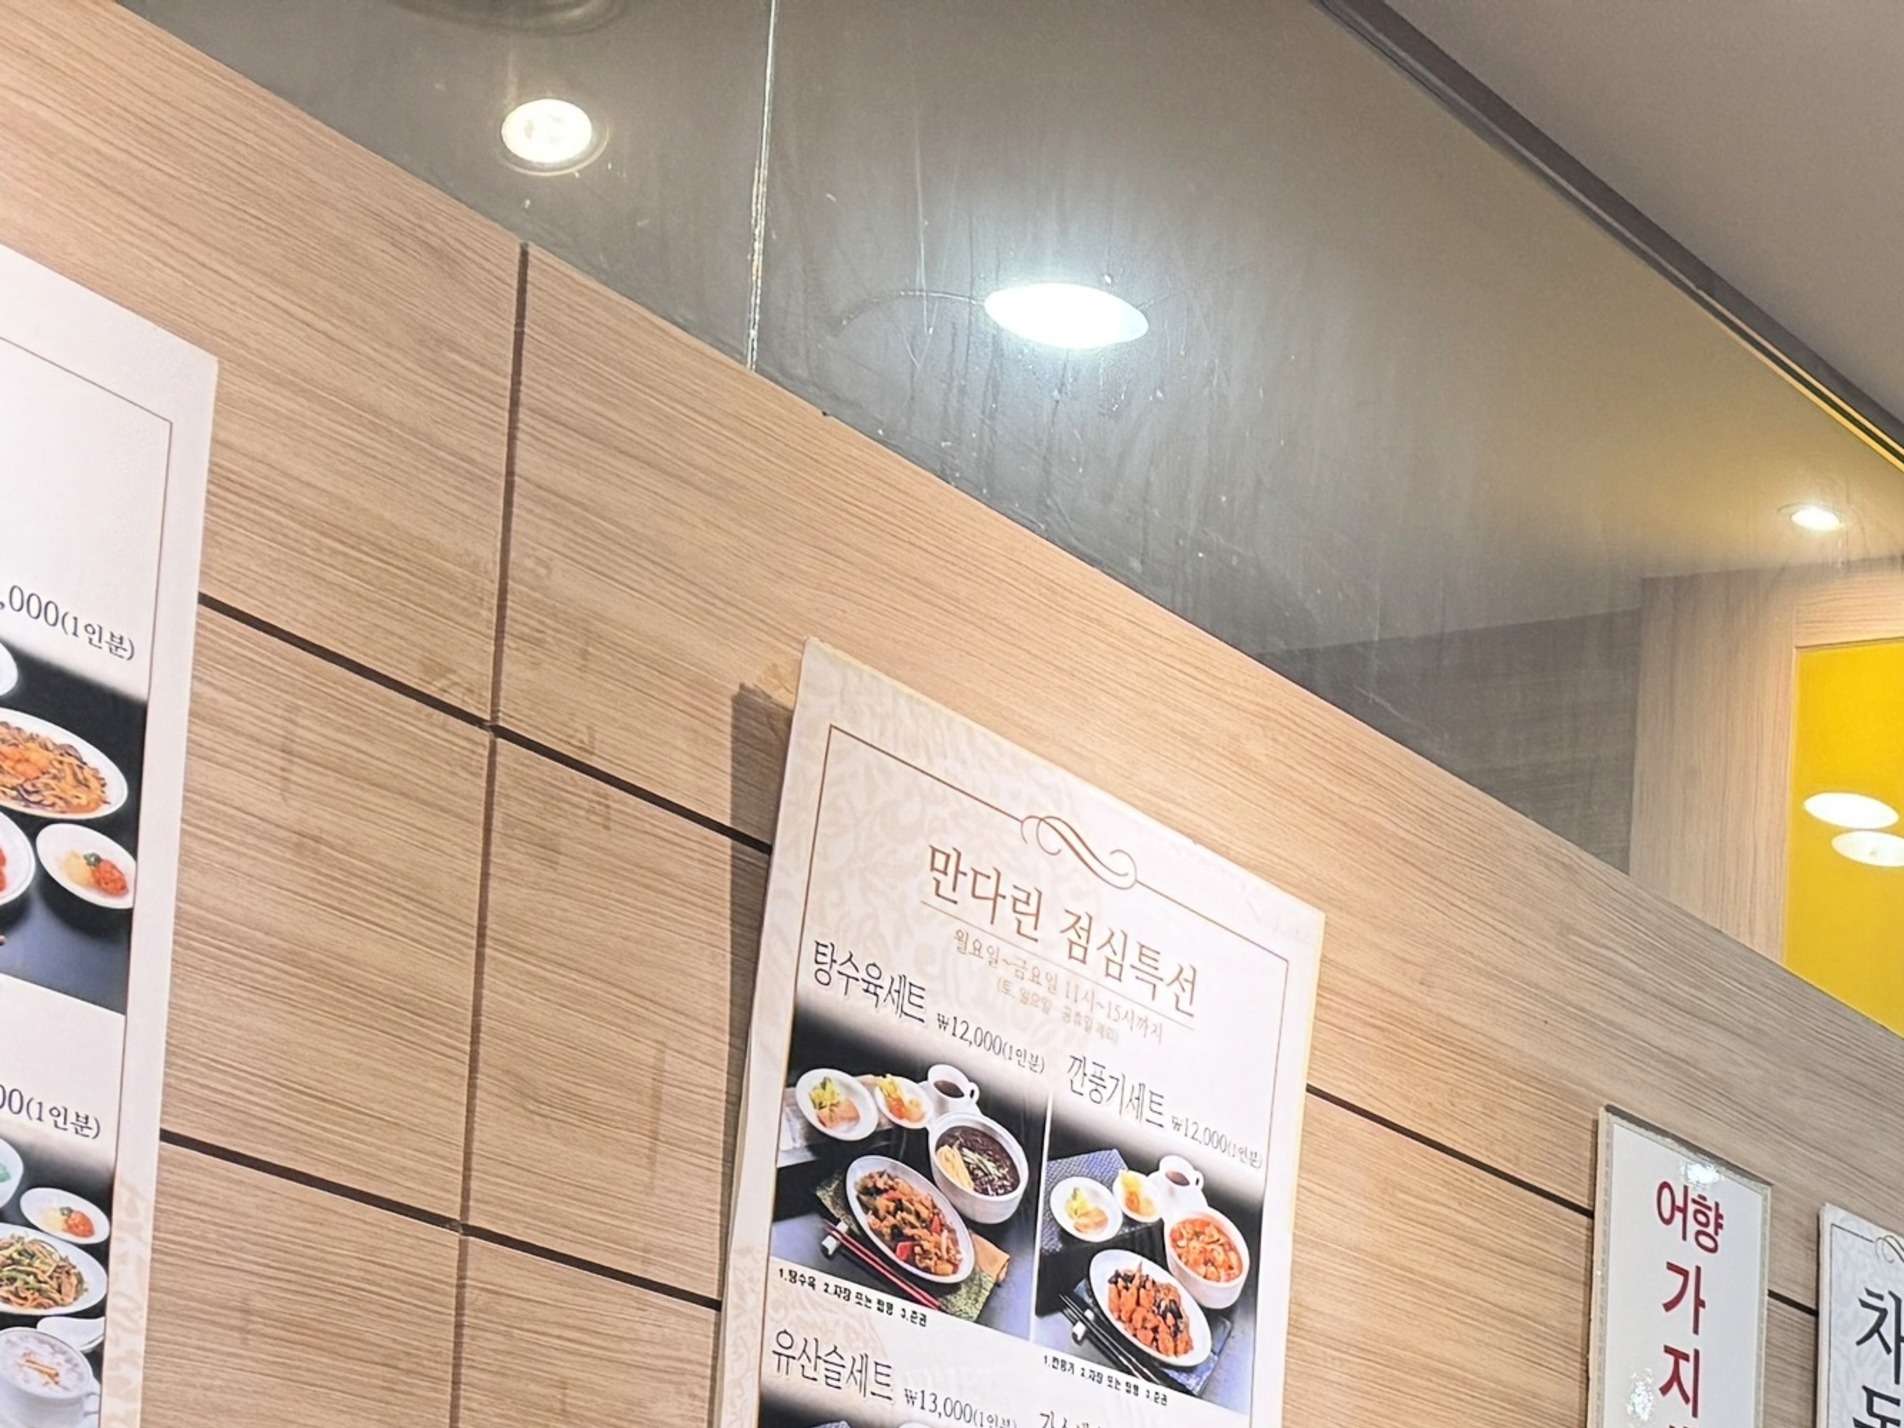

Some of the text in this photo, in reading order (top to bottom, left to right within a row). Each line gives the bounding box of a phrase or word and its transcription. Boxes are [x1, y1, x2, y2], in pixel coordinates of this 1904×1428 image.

[928, 844, 1197, 1018] 만다린 점심특선
[814, 939, 925, 1023] 탕수육세트
[1067, 1054, 1165, 1129] 깐풍기세트
[1655, 1178, 1725, 1257] 어향
[772, 1328, 893, 1401] 유산슬세트
